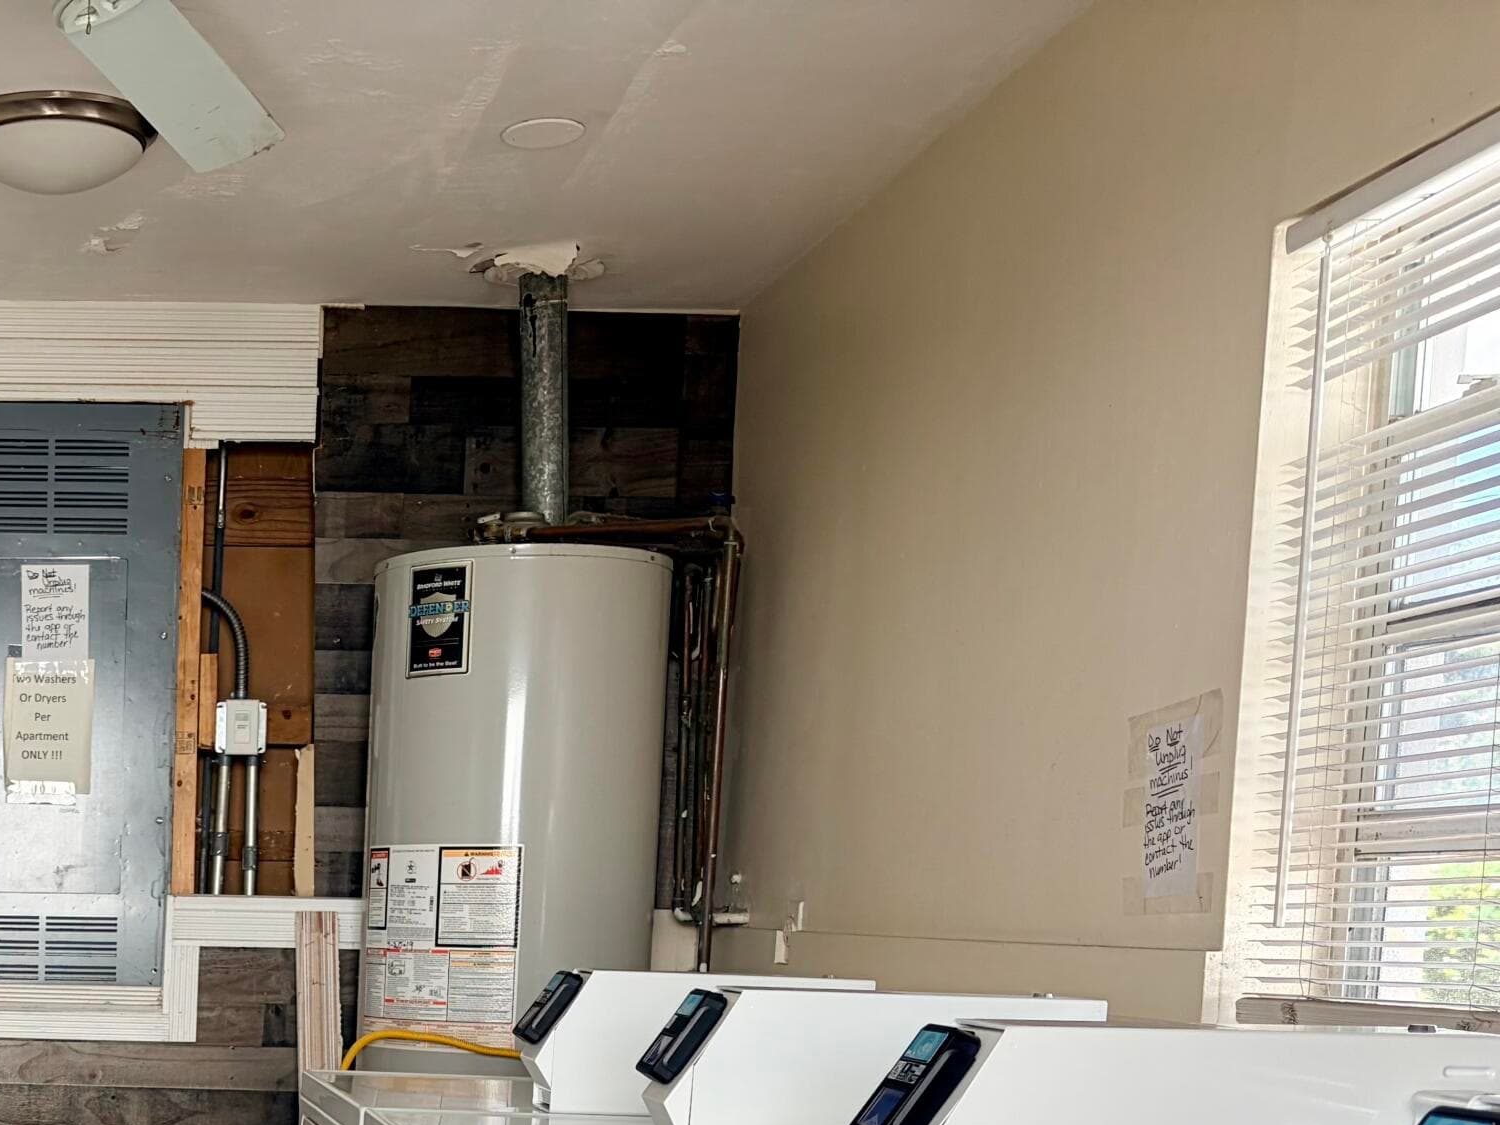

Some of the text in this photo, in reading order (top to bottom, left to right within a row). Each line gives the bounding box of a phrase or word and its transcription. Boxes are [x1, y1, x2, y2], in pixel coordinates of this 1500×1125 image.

[24, 604, 73, 613] Report any
[409, 601, 469, 617] DEFENDER
[26, 609, 86, 623] issues through
[25, 621, 75, 633] the app or
[26, 630, 79, 642] contact the
[34, 674, 77, 684] Washers
[19, 693, 67, 704] Or Dryers
[34, 712, 52, 721] Per
[15, 731, 69, 742] Apartment
[1148, 723, 1183, 747] Do Not
[21, 750, 62, 760] ONLY !!!
[1166, 800, 1196, 826] through
[1169, 798, 1185, 816] any
[1143, 824, 1186, 849] the app or
[1144, 835, 1194, 866] contact the
